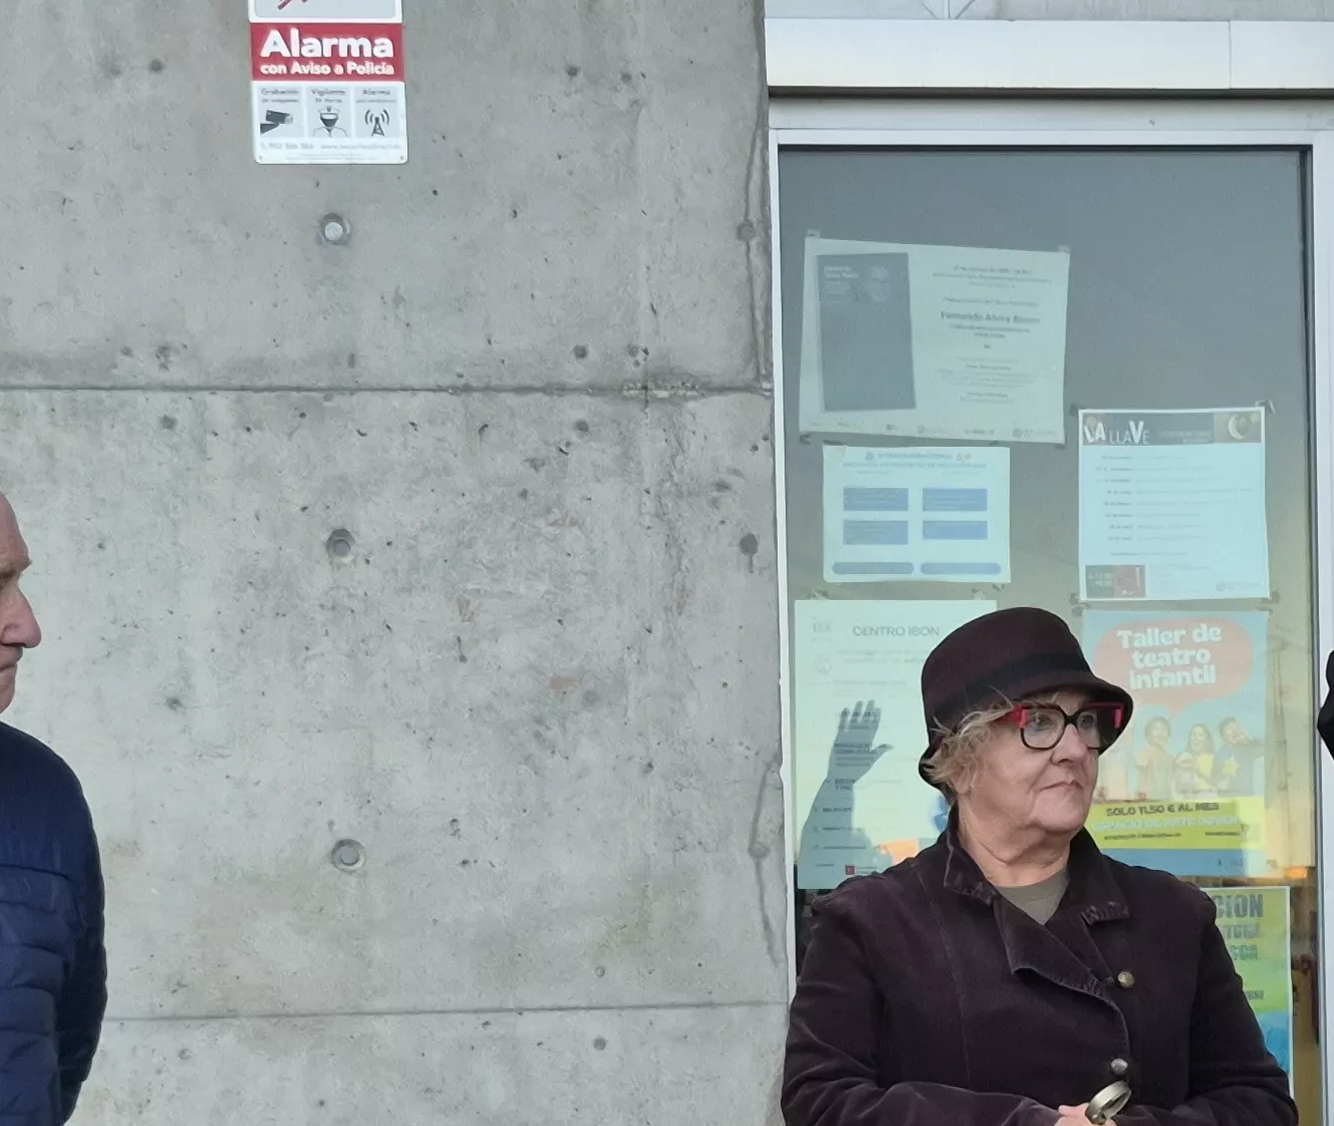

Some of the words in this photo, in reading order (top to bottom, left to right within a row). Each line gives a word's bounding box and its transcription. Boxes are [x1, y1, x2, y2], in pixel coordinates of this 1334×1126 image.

[260, 28, 394, 58] Alarma
[260, 63, 287, 75] con
[290, 61, 331, 75] Aviso
[333, 63, 344, 75] a
[1083, 421, 1107, 444] LA
[852, 625, 905, 637] CENTRO
[1117, 627, 1186, 649] Taller
[1192, 623, 1222, 644] de
[1132, 648, 1211, 669] teatro
[1130, 665, 1216, 690] infantil
[1106, 805, 1136, 817] SOLO
